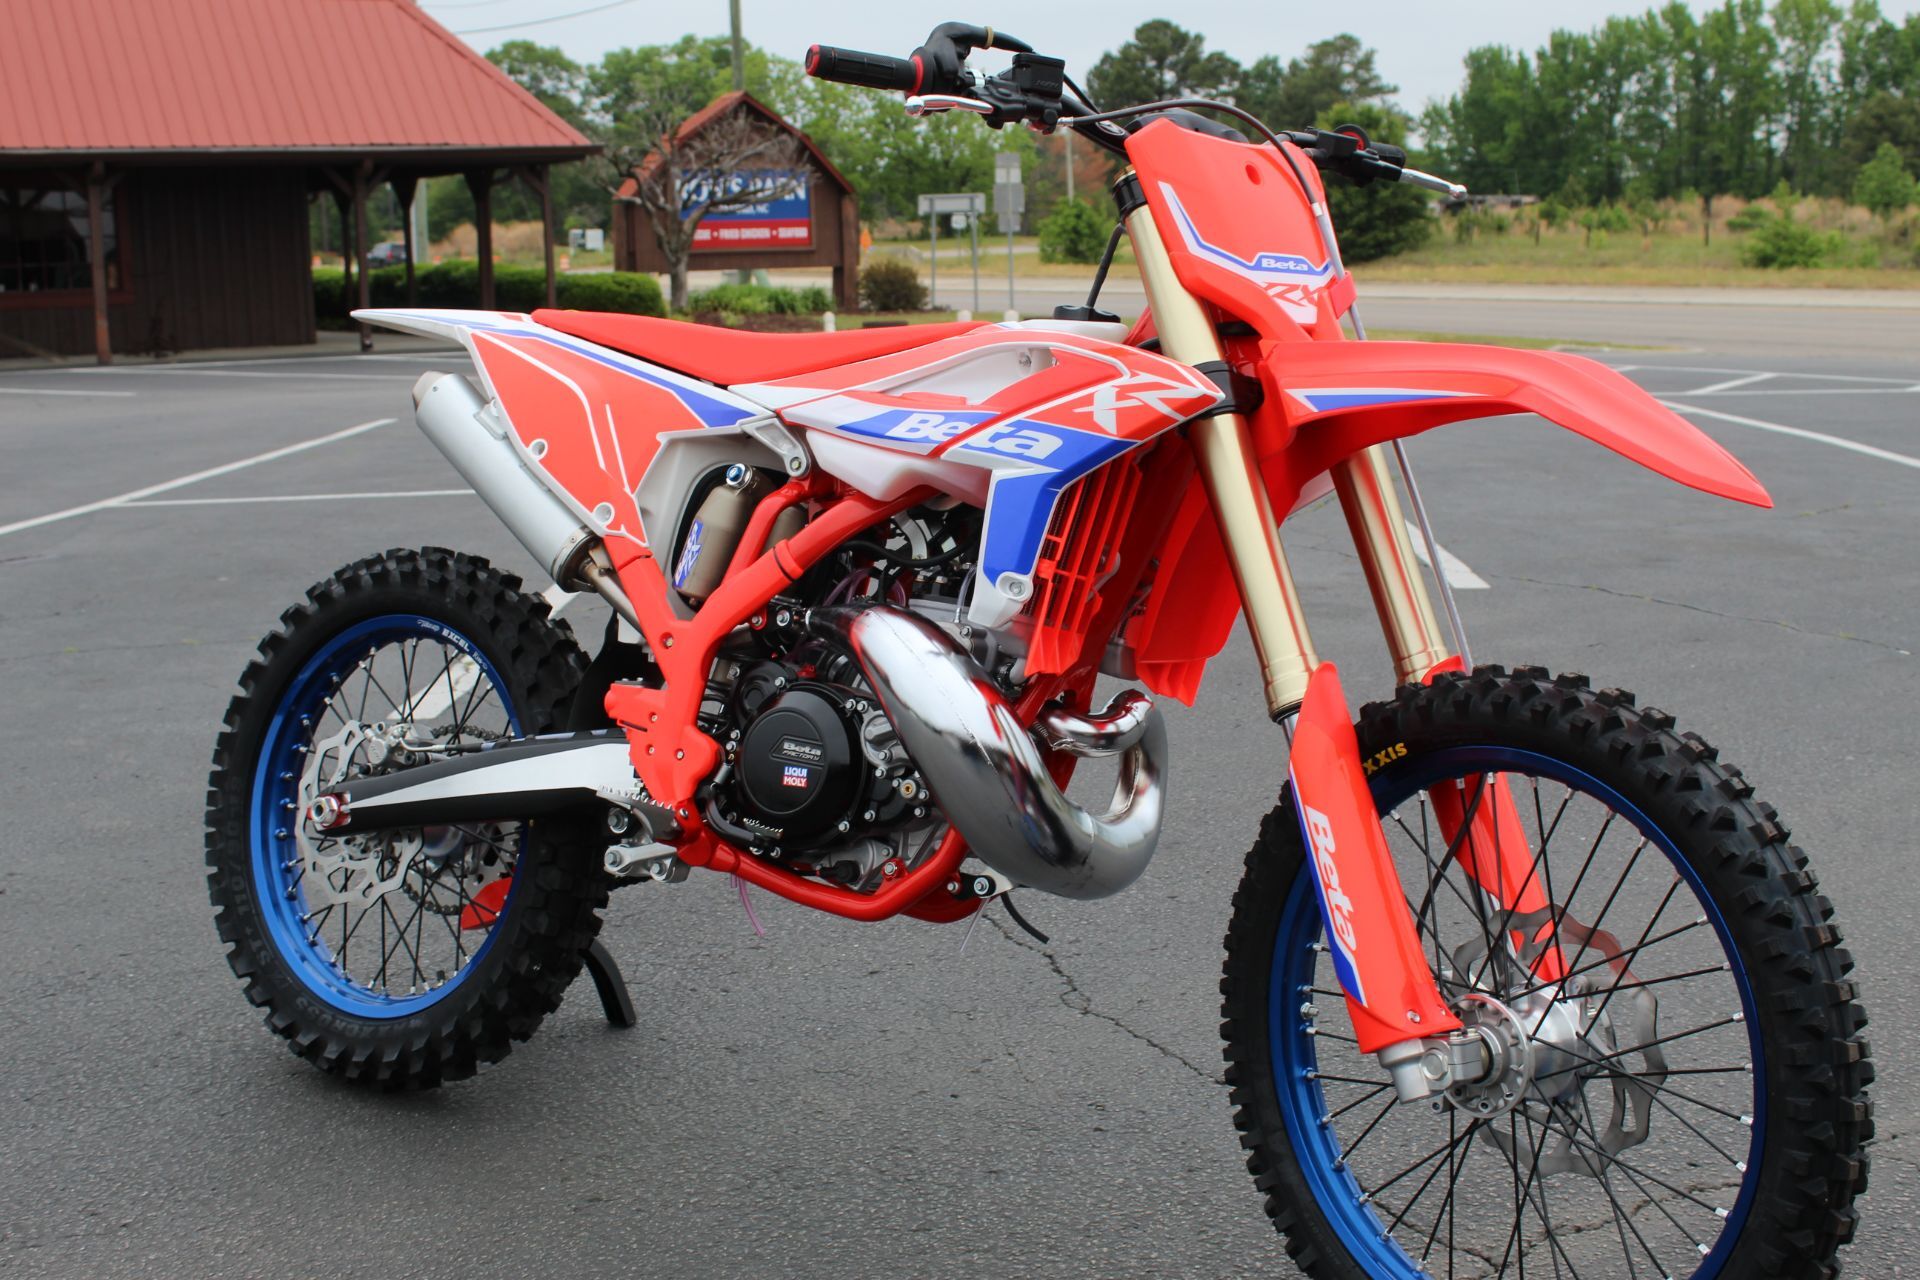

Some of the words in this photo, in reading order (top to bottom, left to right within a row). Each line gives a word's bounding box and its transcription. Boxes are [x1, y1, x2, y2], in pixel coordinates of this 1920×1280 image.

[1261, 257, 1308, 271] Beta
[885, 412, 1063, 460] Beta
[782, 750, 820, 761] FACTORY
[783, 741, 822, 756] Beta
[1362, 742, 1408, 776] XXIS
[784, 766, 808, 777] LIQUI
[783, 776, 808, 788] MOLY
[1304, 804, 1358, 951] Beta
